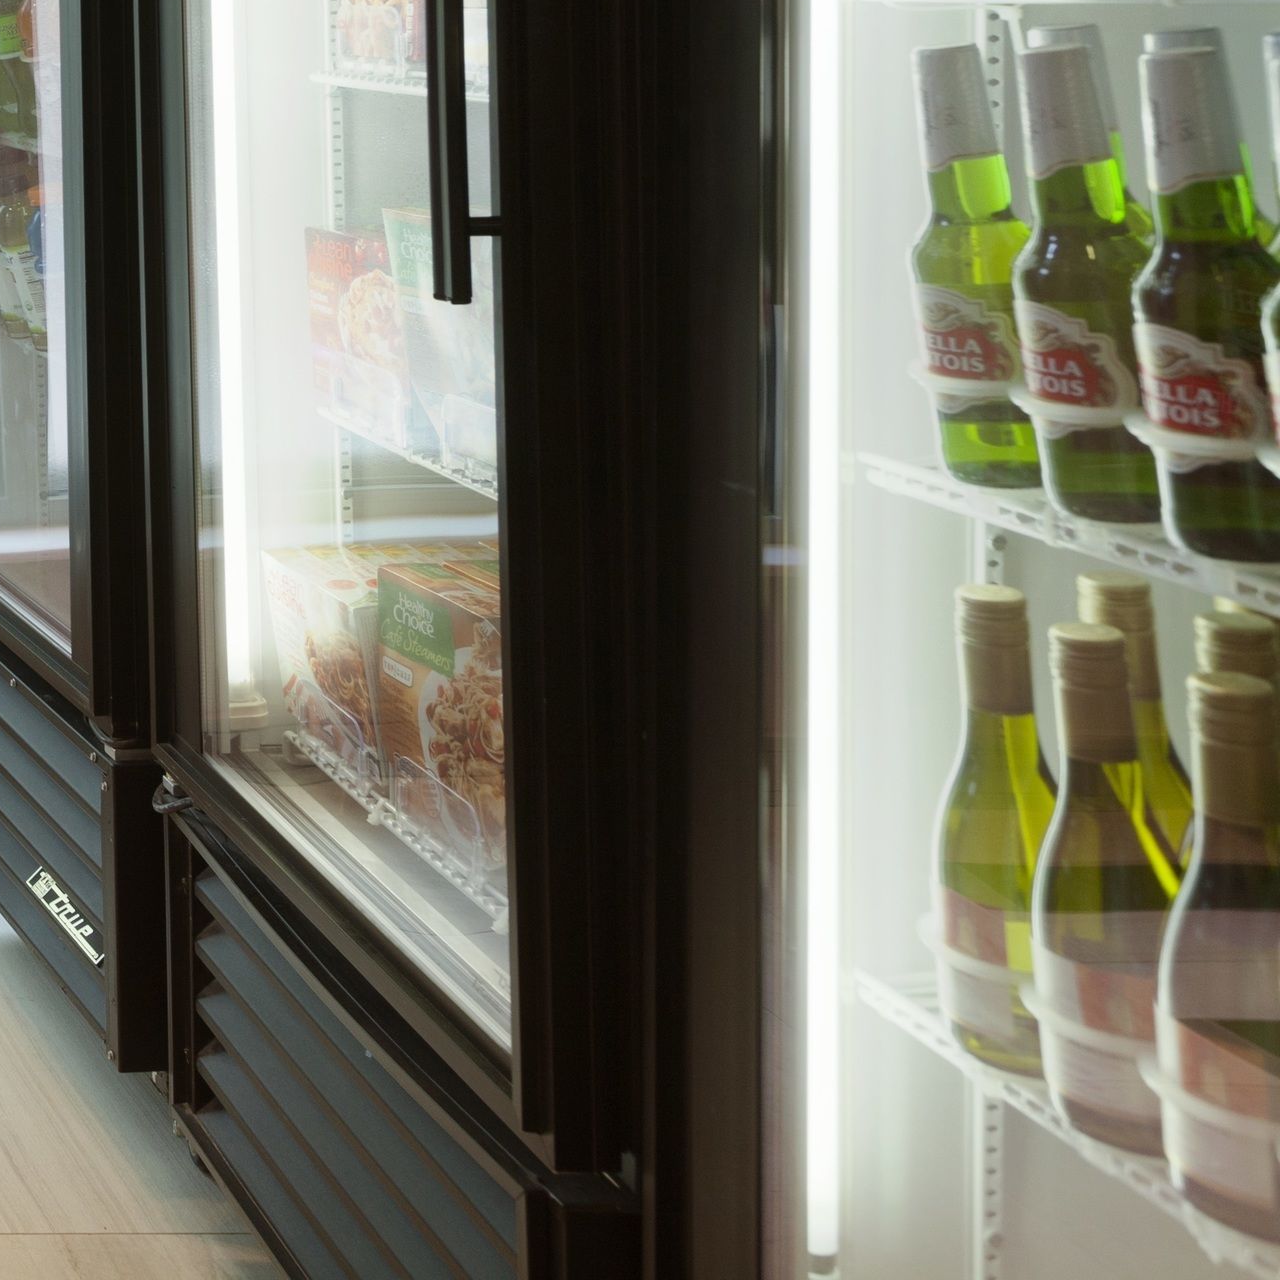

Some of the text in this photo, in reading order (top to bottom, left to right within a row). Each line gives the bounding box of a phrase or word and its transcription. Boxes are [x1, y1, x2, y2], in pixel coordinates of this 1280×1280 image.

[927, 335, 983, 355] ELLA
[927, 353, 986, 374] TOIS
[392, 604, 436, 640] Choice
[397, 590, 435, 624] Healthy
[401, 628, 453, 673] Steamers
